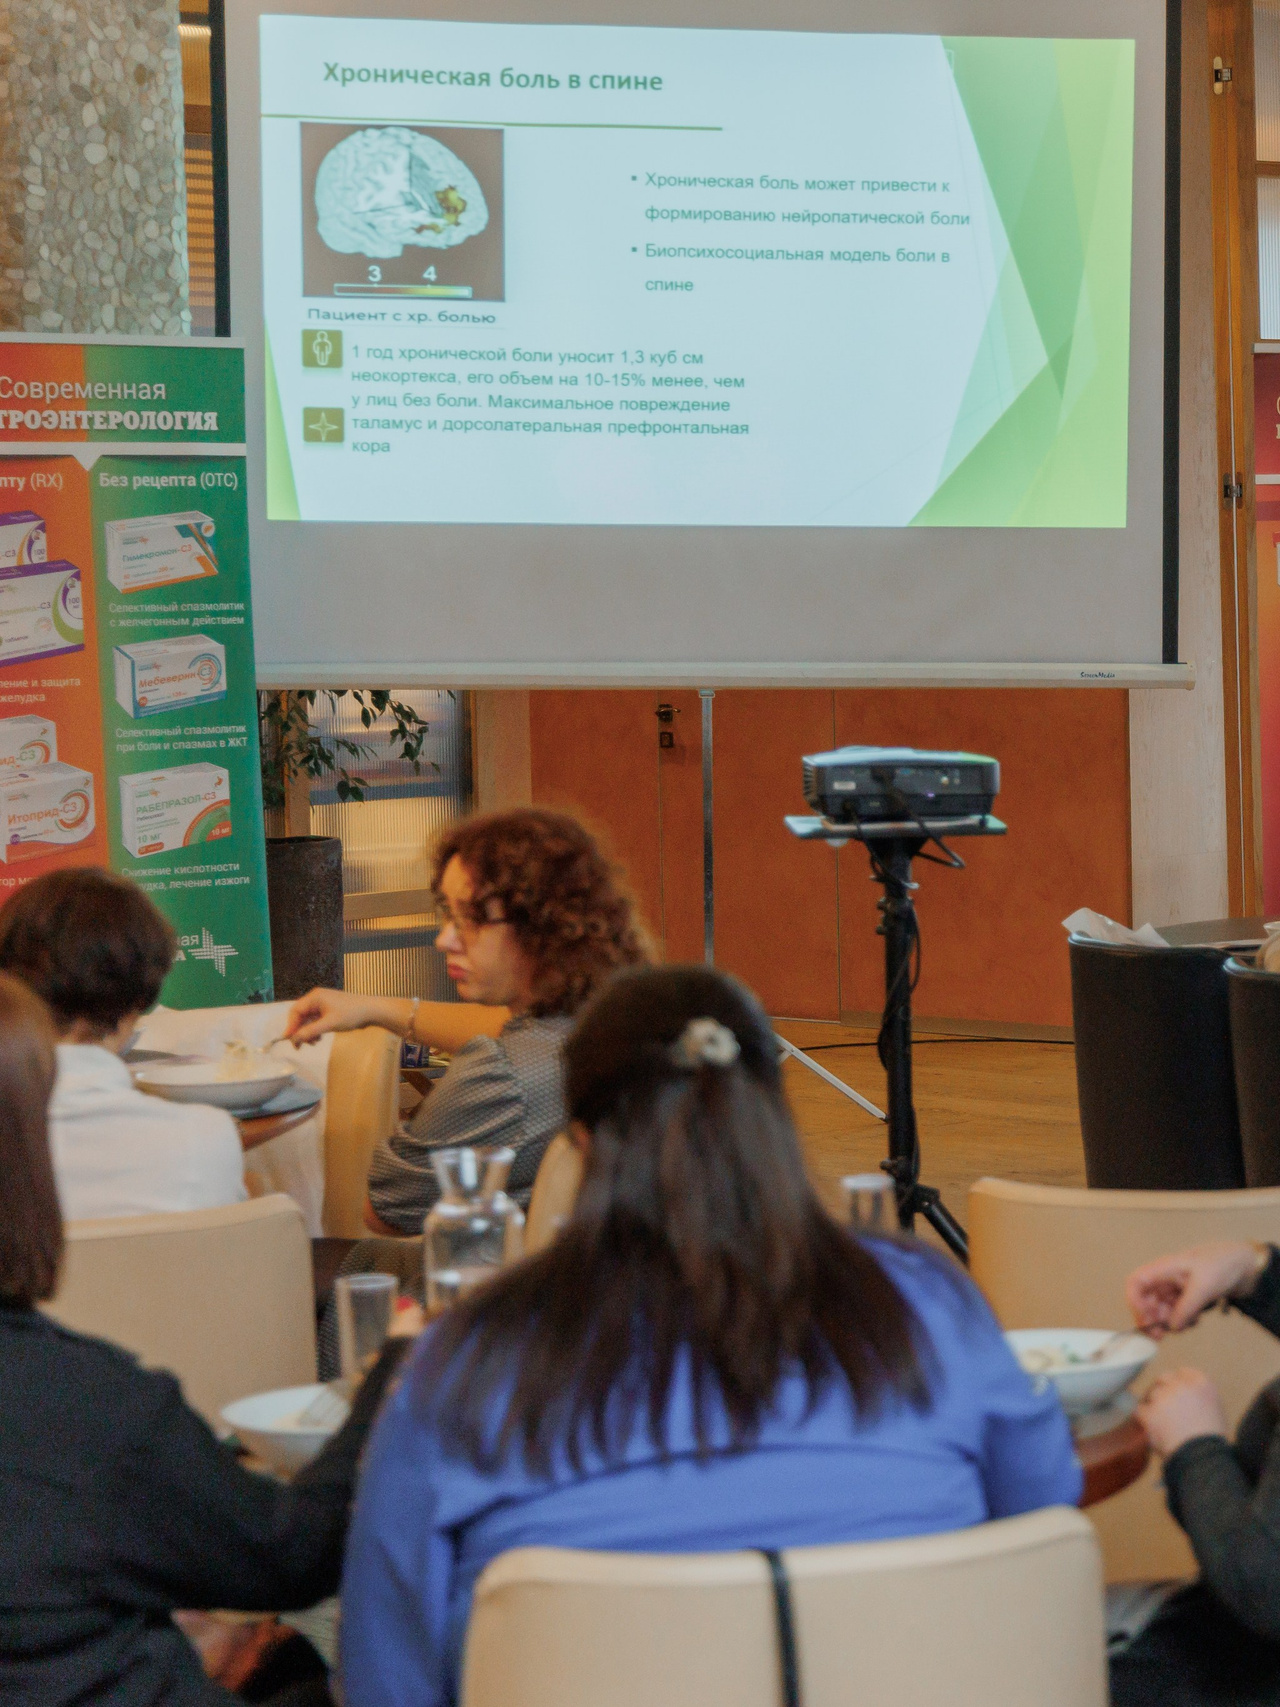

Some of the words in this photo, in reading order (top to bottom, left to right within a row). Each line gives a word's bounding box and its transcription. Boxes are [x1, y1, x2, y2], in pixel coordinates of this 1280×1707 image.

[323, 62, 491, 87] Хроническая
[500, 67, 560, 89] боль
[568, 74, 581, 89] в
[589, 74, 663, 90] спине
[645, 172, 754, 190] Хроническая
[759, 175, 799, 191] боль
[805, 179, 855, 191] может
[861, 180, 937, 195] привести
[942, 181, 951, 192] к
[645, 205, 776, 224] формированию
[781, 208, 925, 227] нейропатической
[930, 210, 970, 226] боли
[645, 243, 824, 263] Биопсихосоциальная
[830, 249, 891, 264] модель
[896, 247, 936, 263] боли
[941, 252, 950, 263] в
[368, 265, 382, 282] 3
[422, 265, 437, 282] 4
[645, 279, 694, 292] спине
[307, 308, 387, 322] Пациент
[393, 313, 402, 322] с
[408, 313, 432, 324] хр.
[437, 310, 496, 323] болью
[353, 345, 359, 358] 1
[366, 348, 393, 361] год
[399, 347, 507, 362] хронической
[512, 348, 552, 362] боли
[558, 351, 614, 366] уносит
[621, 350, 645, 366] 1,3
[650, 350, 677, 367] куб
[682, 353, 704, 364] см
[351, 370, 462, 386] неокортекса,
[467, 373, 494, 384] его
[499, 371, 553, 385] объем
[559, 375, 578, 386] на
[585, 372, 646, 387] 10-15%
[651, 376, 708, 389] менее,
[714, 377, 745, 388] чем
[0, 376, 166, 404] Современная
[351, 395, 360, 408] у
[366, 395, 397, 408] лиц
[403, 393, 431, 407] без
[436, 393, 482, 407] боли.
[488, 395, 614, 410] Максимальное
[619, 399, 731, 414] повреждение
[352, 417, 422, 432] таламус
[428, 419, 437, 430] и
[443, 418, 602, 435] дорсолатеральная
[608, 420, 749, 436] префронтальная
[352, 441, 391, 455] кора
[30, 472, 63, 491] (RX)
[100, 473, 128, 487] Без
[133, 474, 196, 490] рецепта
[109, 601, 178, 613] Селективный
[181, 602, 245, 612] спазмолитик
[118, 617, 189, 627] желчегонным
[192, 615, 245, 627] действием
[41, 678, 81, 689] защита
[115, 725, 181, 738] Селективный
[184, 725, 246, 735] спазмолитик
[116, 742, 135, 753] при
[138, 741, 161, 751] боли
[172, 740, 217, 749] спазмах
[228, 737, 248, 748] ЖКТ
[174, 863, 240, 875] кислотности
[169, 878, 212, 889] лечение
[214, 876, 251, 886] изжоги
